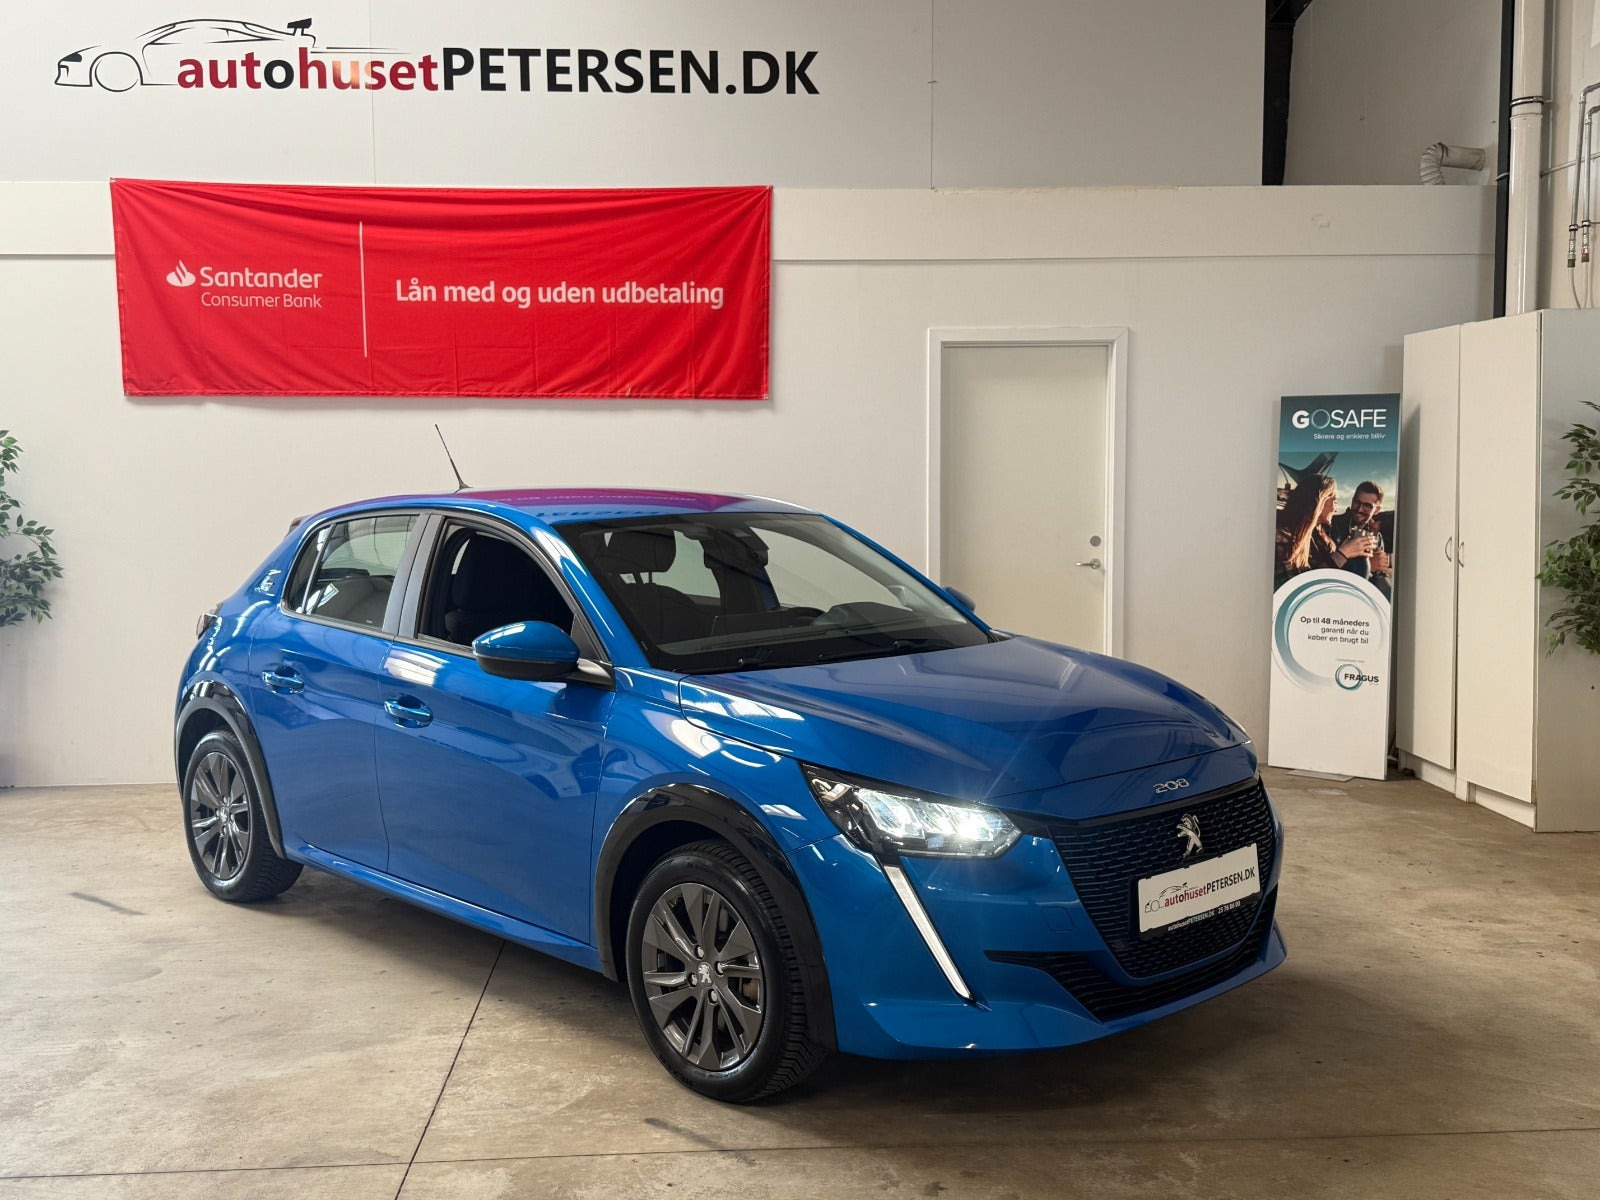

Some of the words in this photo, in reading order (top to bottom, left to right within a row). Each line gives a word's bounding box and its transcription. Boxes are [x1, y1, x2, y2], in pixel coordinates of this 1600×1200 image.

[177, 46, 820, 96] autohusetPETERSEN.DK
[200, 266, 323, 289] Santander
[201, 292, 280, 308] Consumer
[283, 293, 323, 309] Bank
[395, 277, 437, 302] Lån
[443, 280, 495, 303] med
[502, 285, 531, 309] og
[538, 281, 596, 304] uden
[602, 281, 724, 310] udbetaling
[1291, 408, 1388, 429] GOSAFE
[1300, 616, 1312, 624] Op
[1312, 616, 1320, 624] til
[1320, 617, 1331, 625] 48
[1332, 618, 1370, 627] måneders
[1307, 633, 1328, 641] køber
[1339, 635, 1359, 645] brugt
[1360, 636, 1369, 644] bil
[1346, 627, 1358, 635] når
[1344, 673, 1379, 683] FRAGUS
[1152, 778, 1190, 793] 208
[1164, 866, 1256, 908] autohusetPETERSEN.DK
